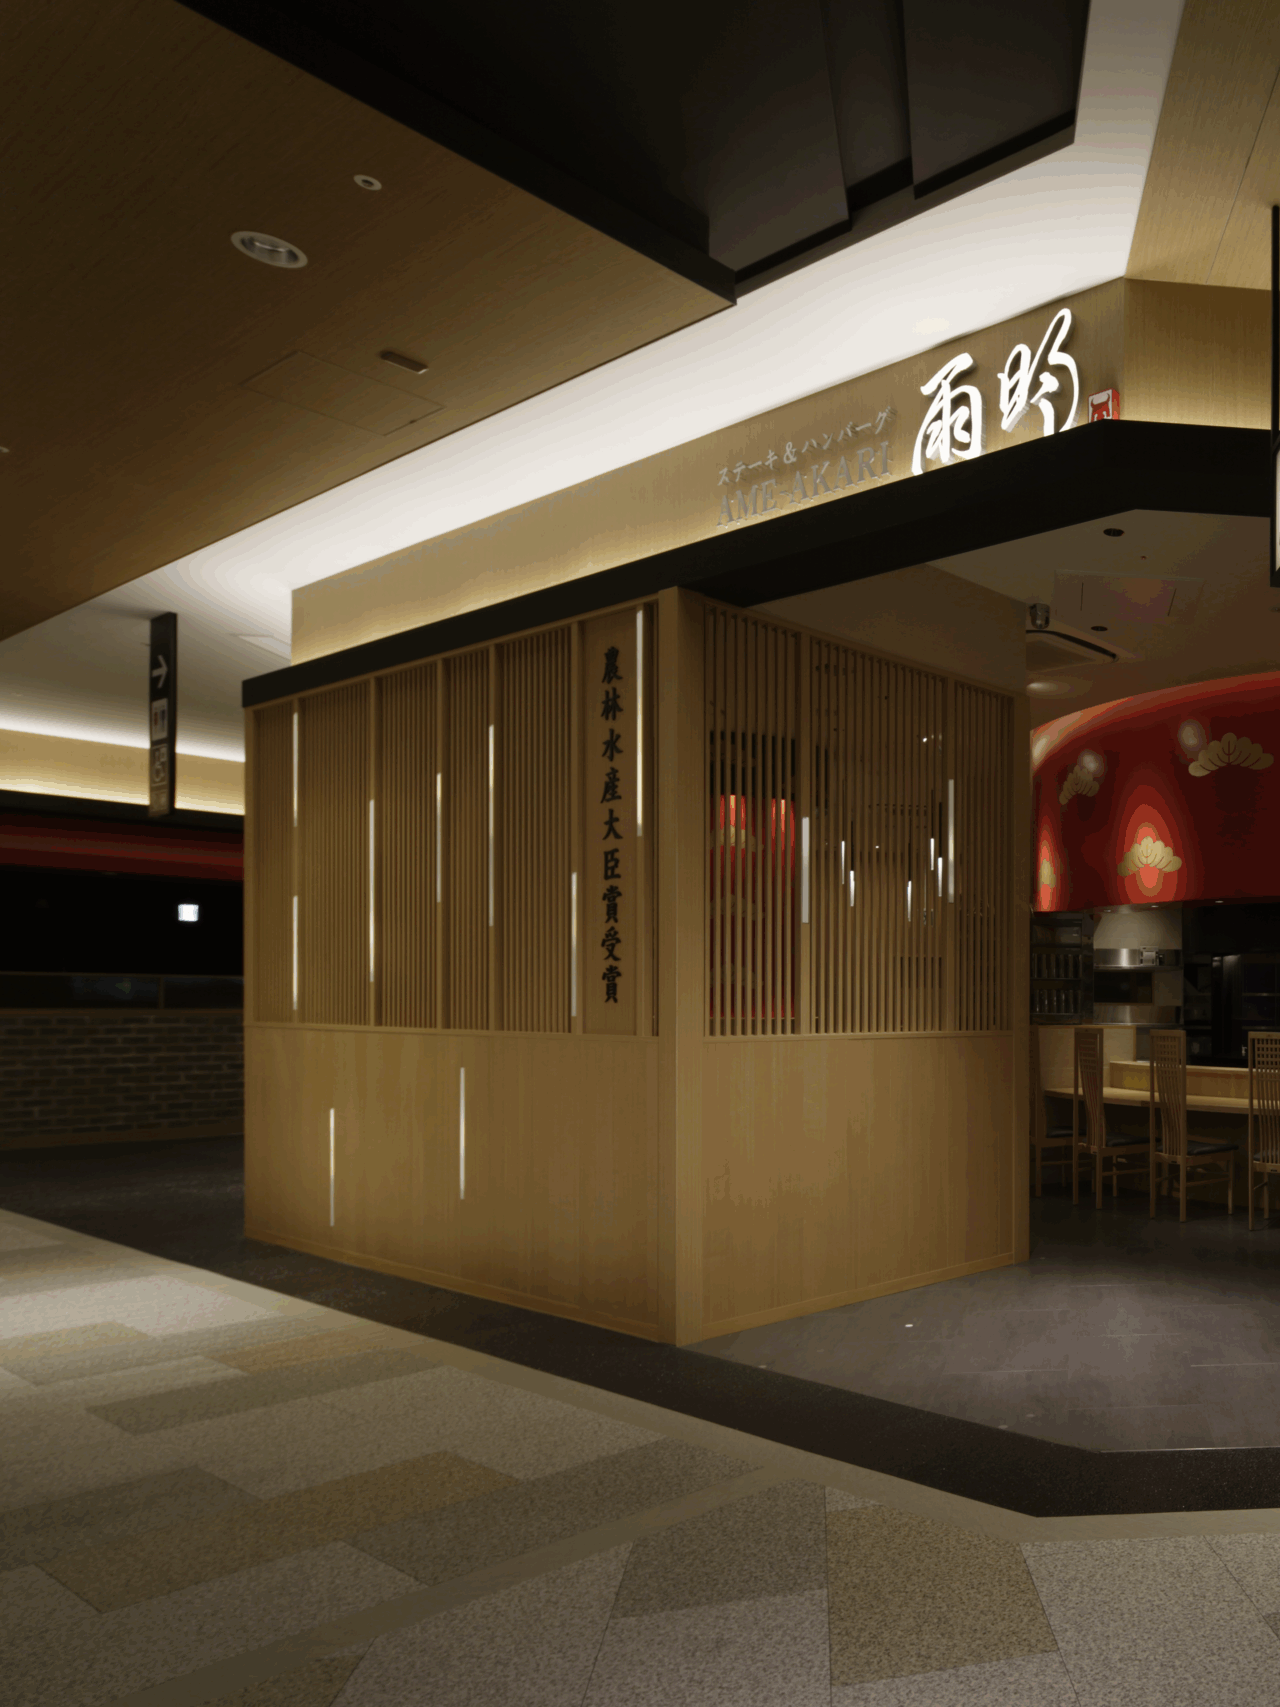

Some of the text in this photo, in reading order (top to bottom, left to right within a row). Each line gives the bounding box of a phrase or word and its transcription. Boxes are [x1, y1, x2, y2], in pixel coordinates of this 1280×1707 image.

[716, 441, 893, 528] AME-AKARI
[600, 646, 624, 1004] 農林水産大臣賞受賞
